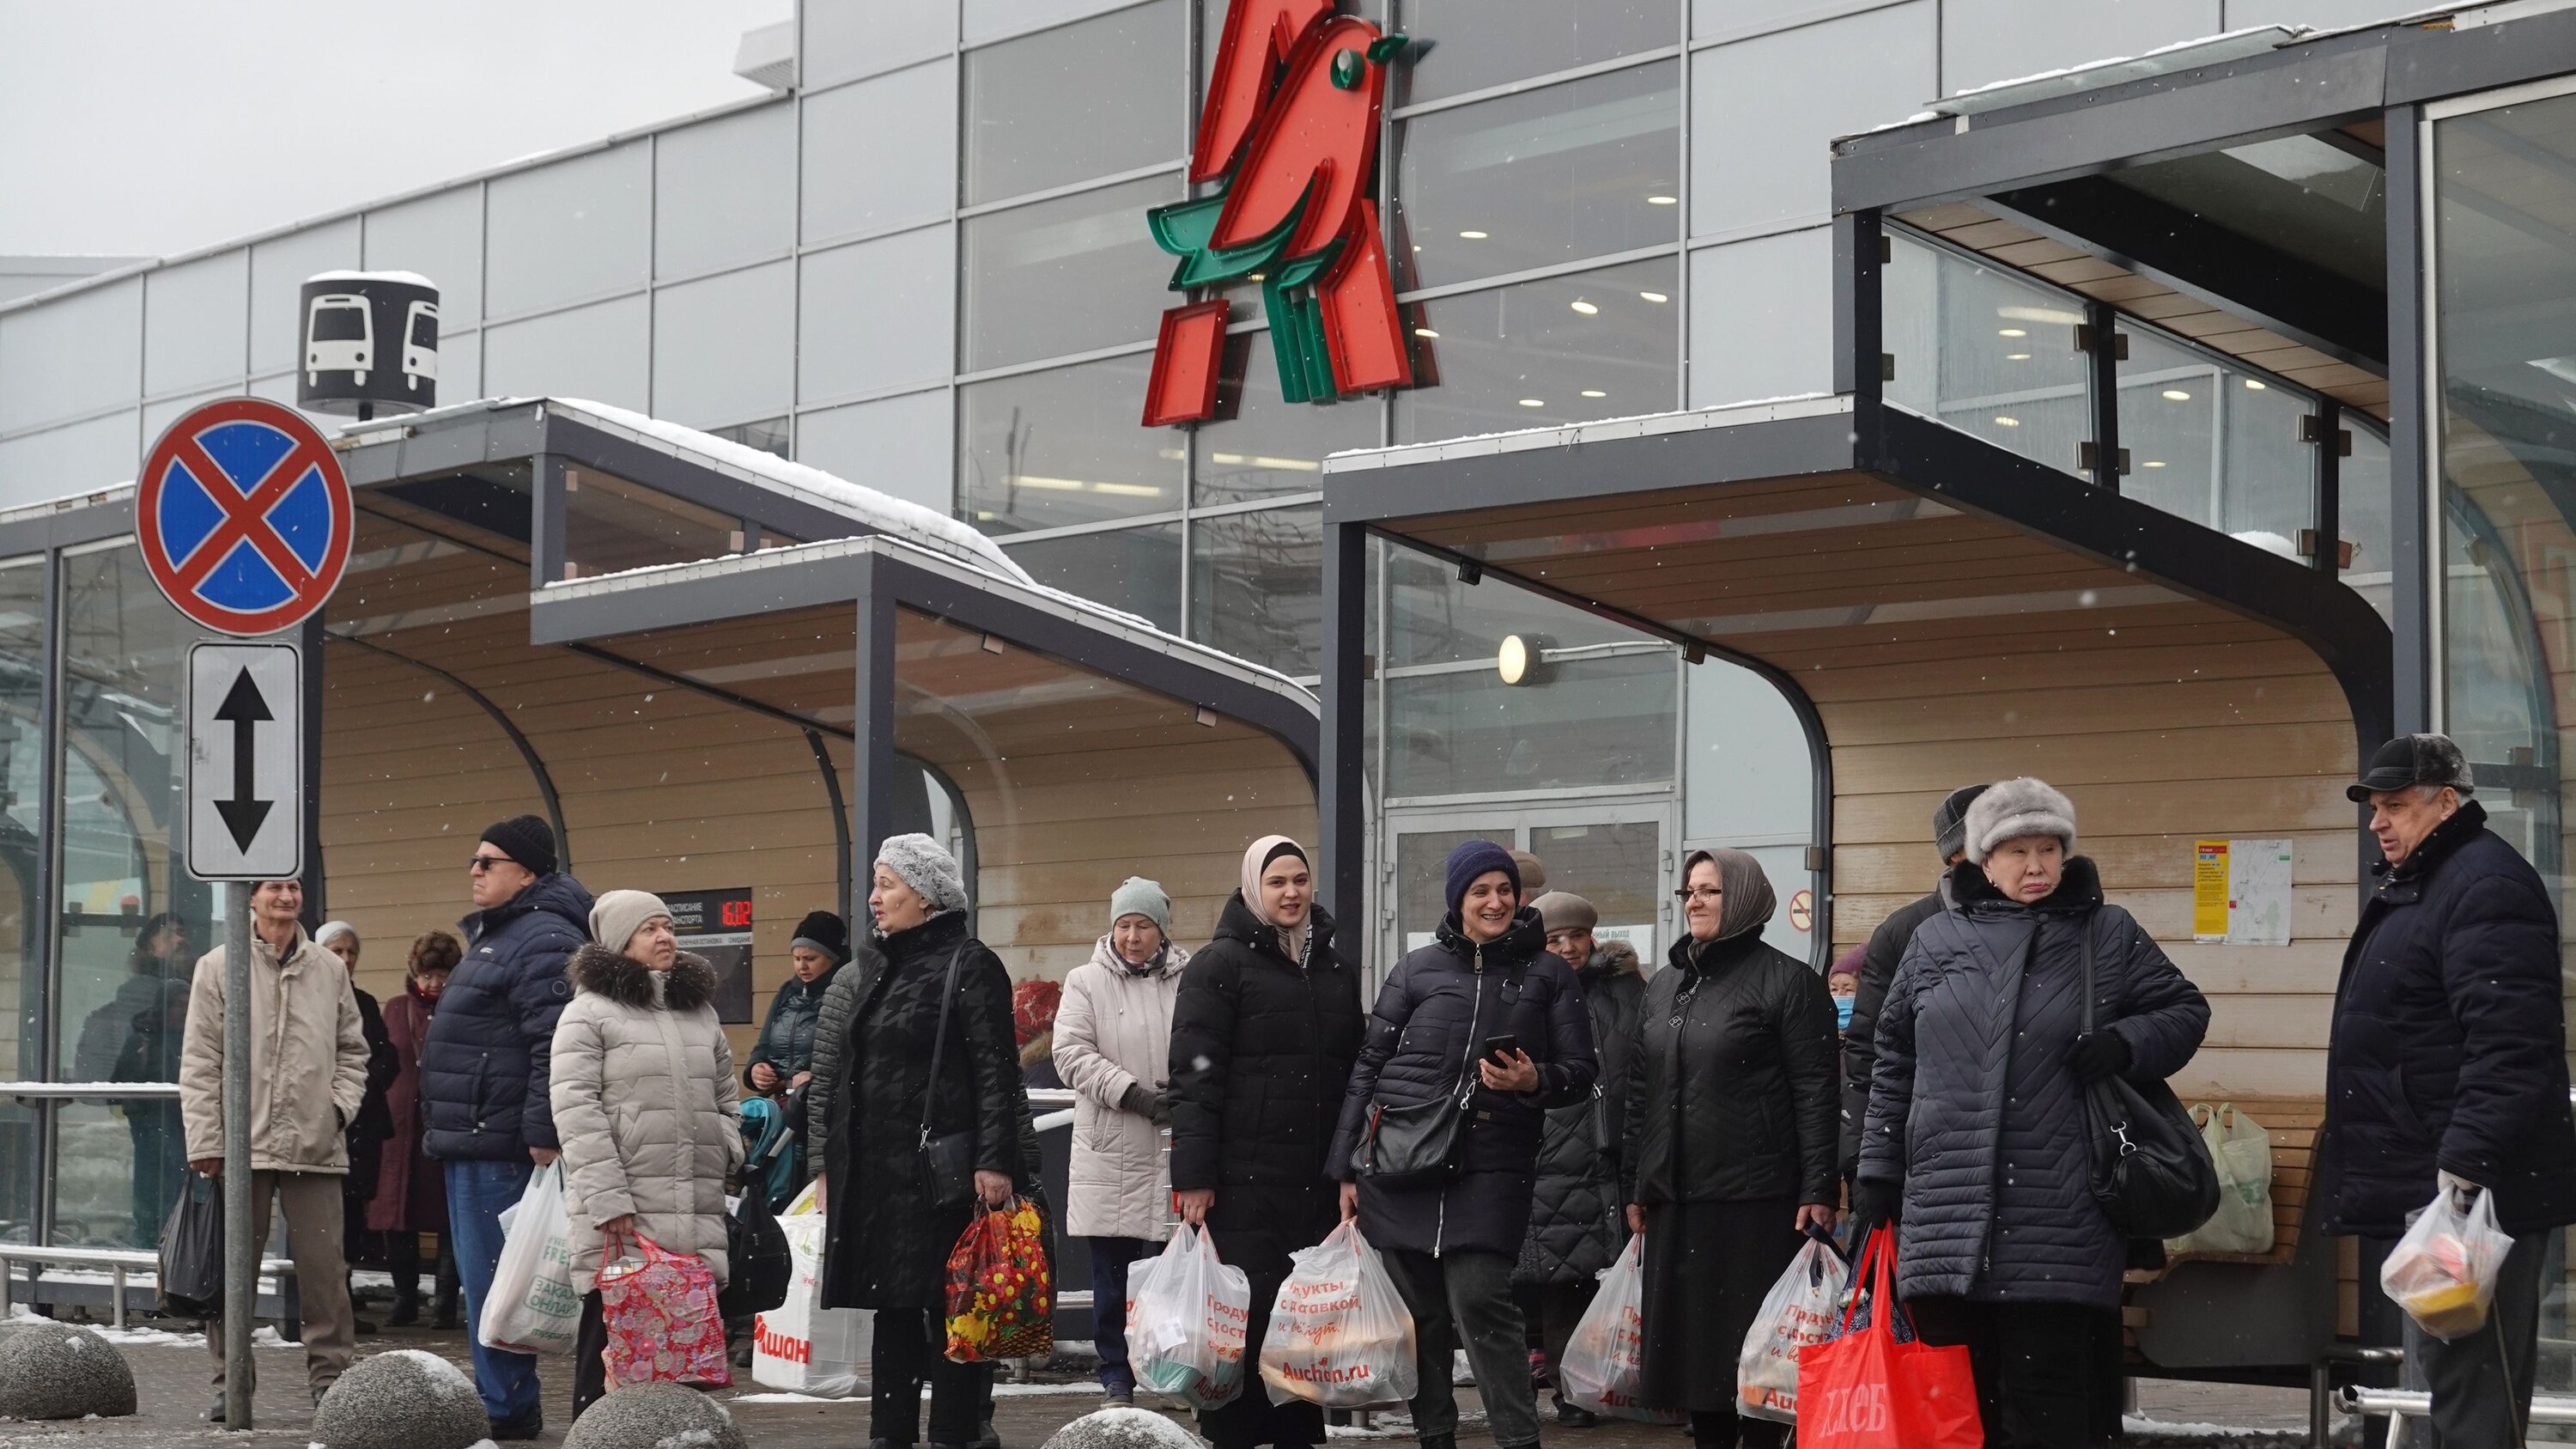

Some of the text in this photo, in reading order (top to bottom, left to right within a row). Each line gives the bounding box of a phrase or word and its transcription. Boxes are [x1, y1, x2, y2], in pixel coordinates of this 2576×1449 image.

[673, 915, 702, 924] АНСПОРТА
[543, 1245, 570, 1265] FRE
[530, 1295, 578, 1314] ОНЛАЙ
[1283, 1361, 1370, 1384] Auchan.ru
